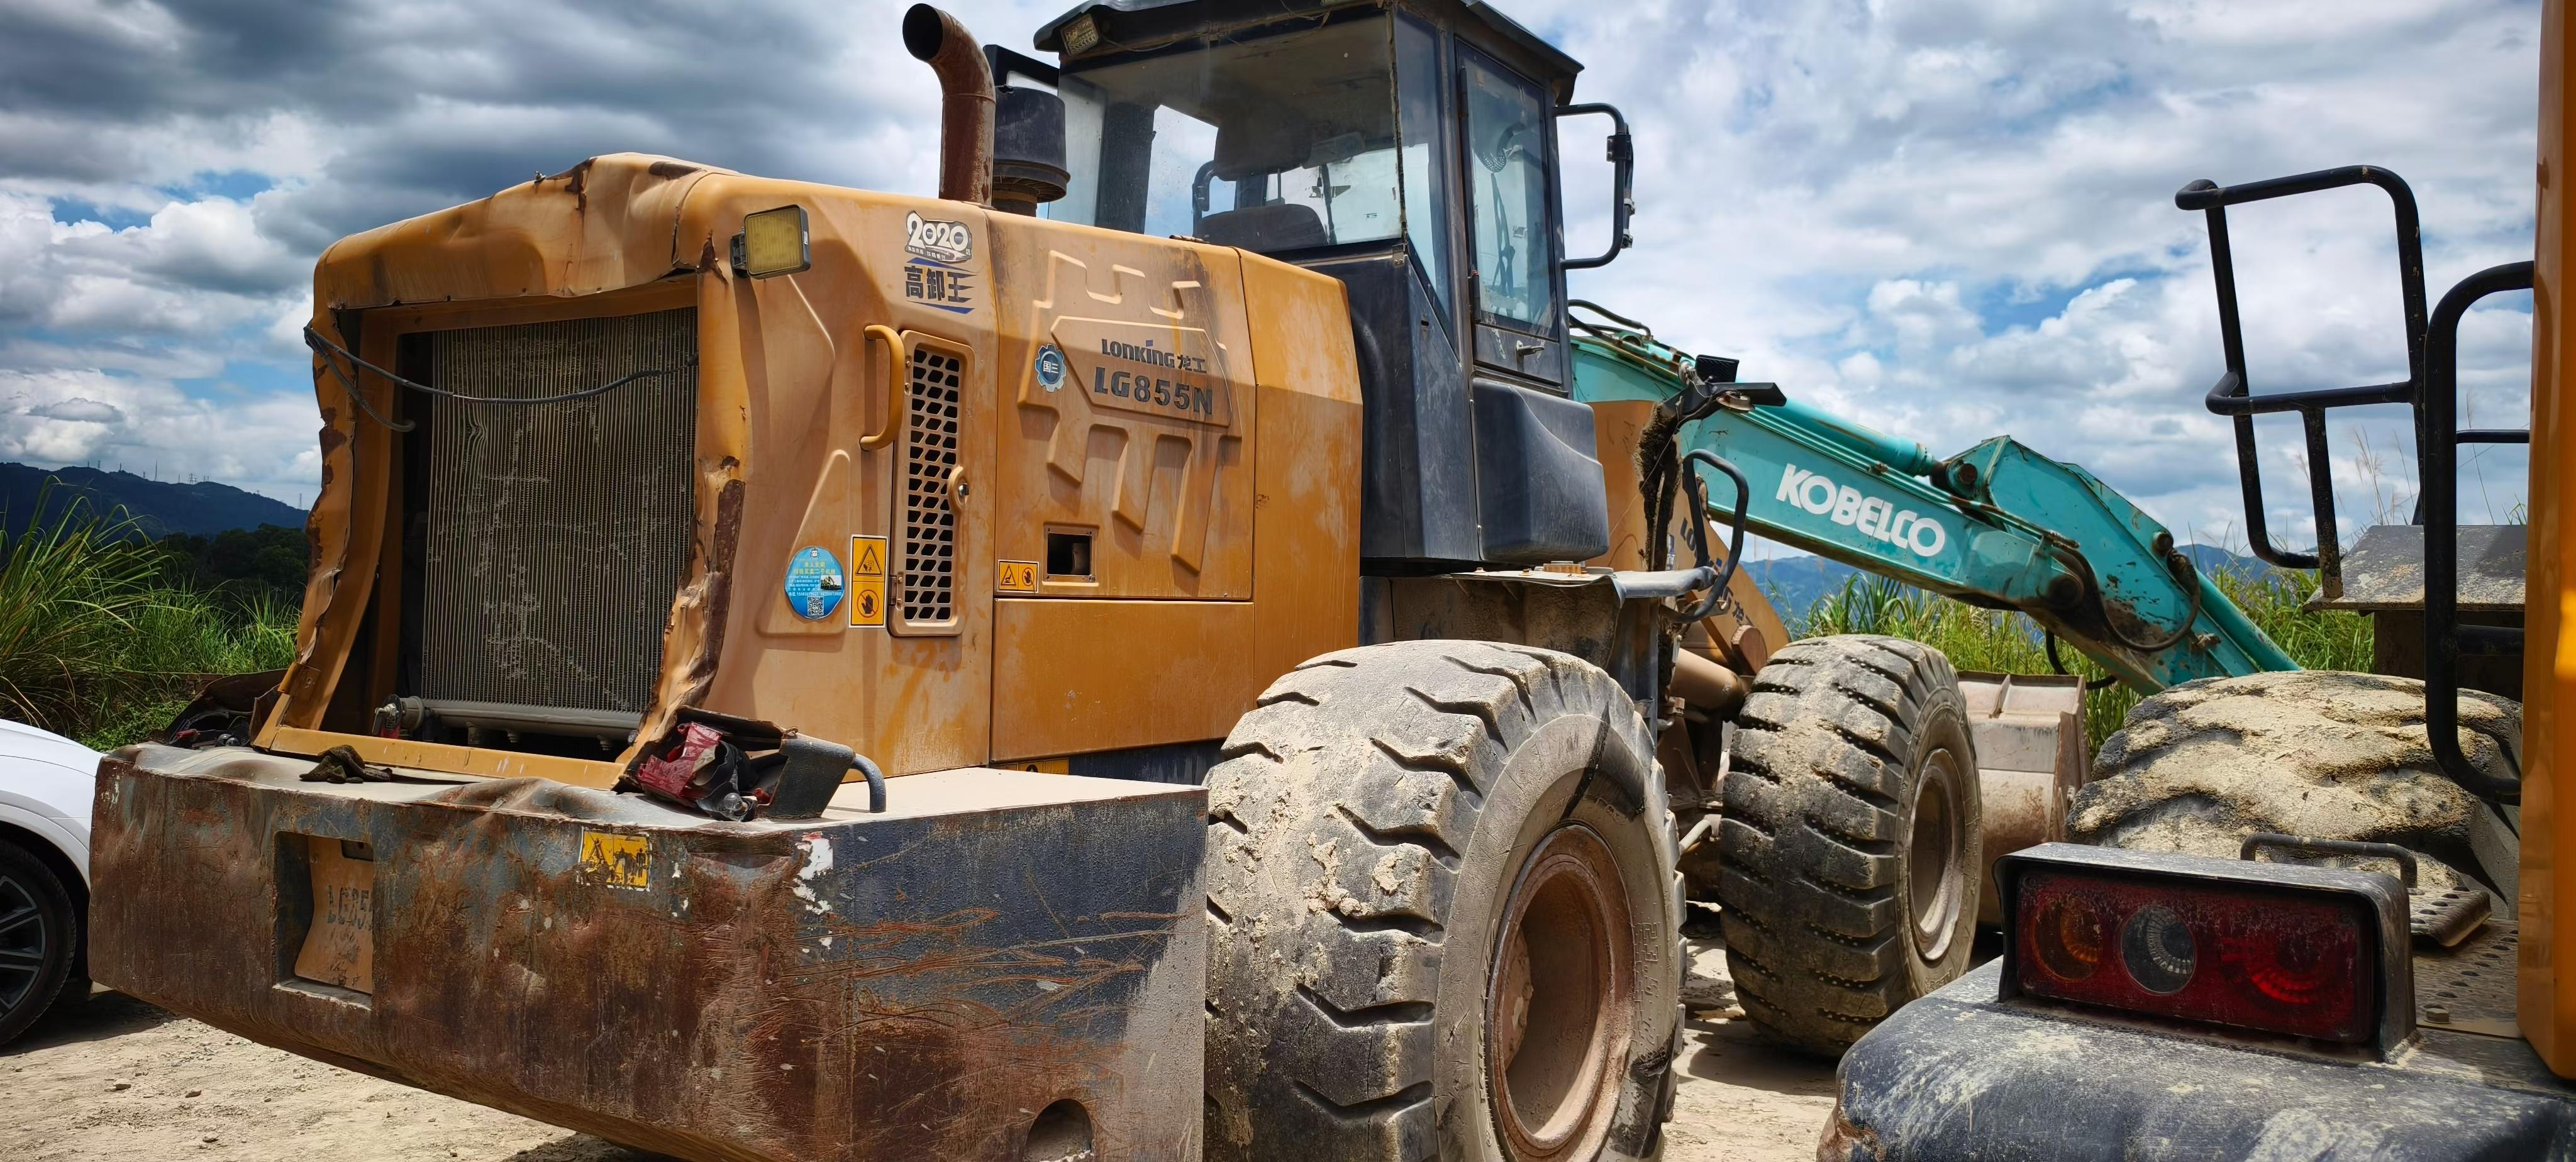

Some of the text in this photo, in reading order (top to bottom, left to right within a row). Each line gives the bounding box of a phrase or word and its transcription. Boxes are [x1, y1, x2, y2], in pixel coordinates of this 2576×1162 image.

[907, 213, 969, 252] 2020
[904, 265, 978, 303] 高卸王
[1043, 360, 1060, 375] 国三
[1177, 355, 1208, 374] 龙工
[1094, 367, 1213, 415] LG855N
[1775, 463, 1945, 557] KOBELCO
